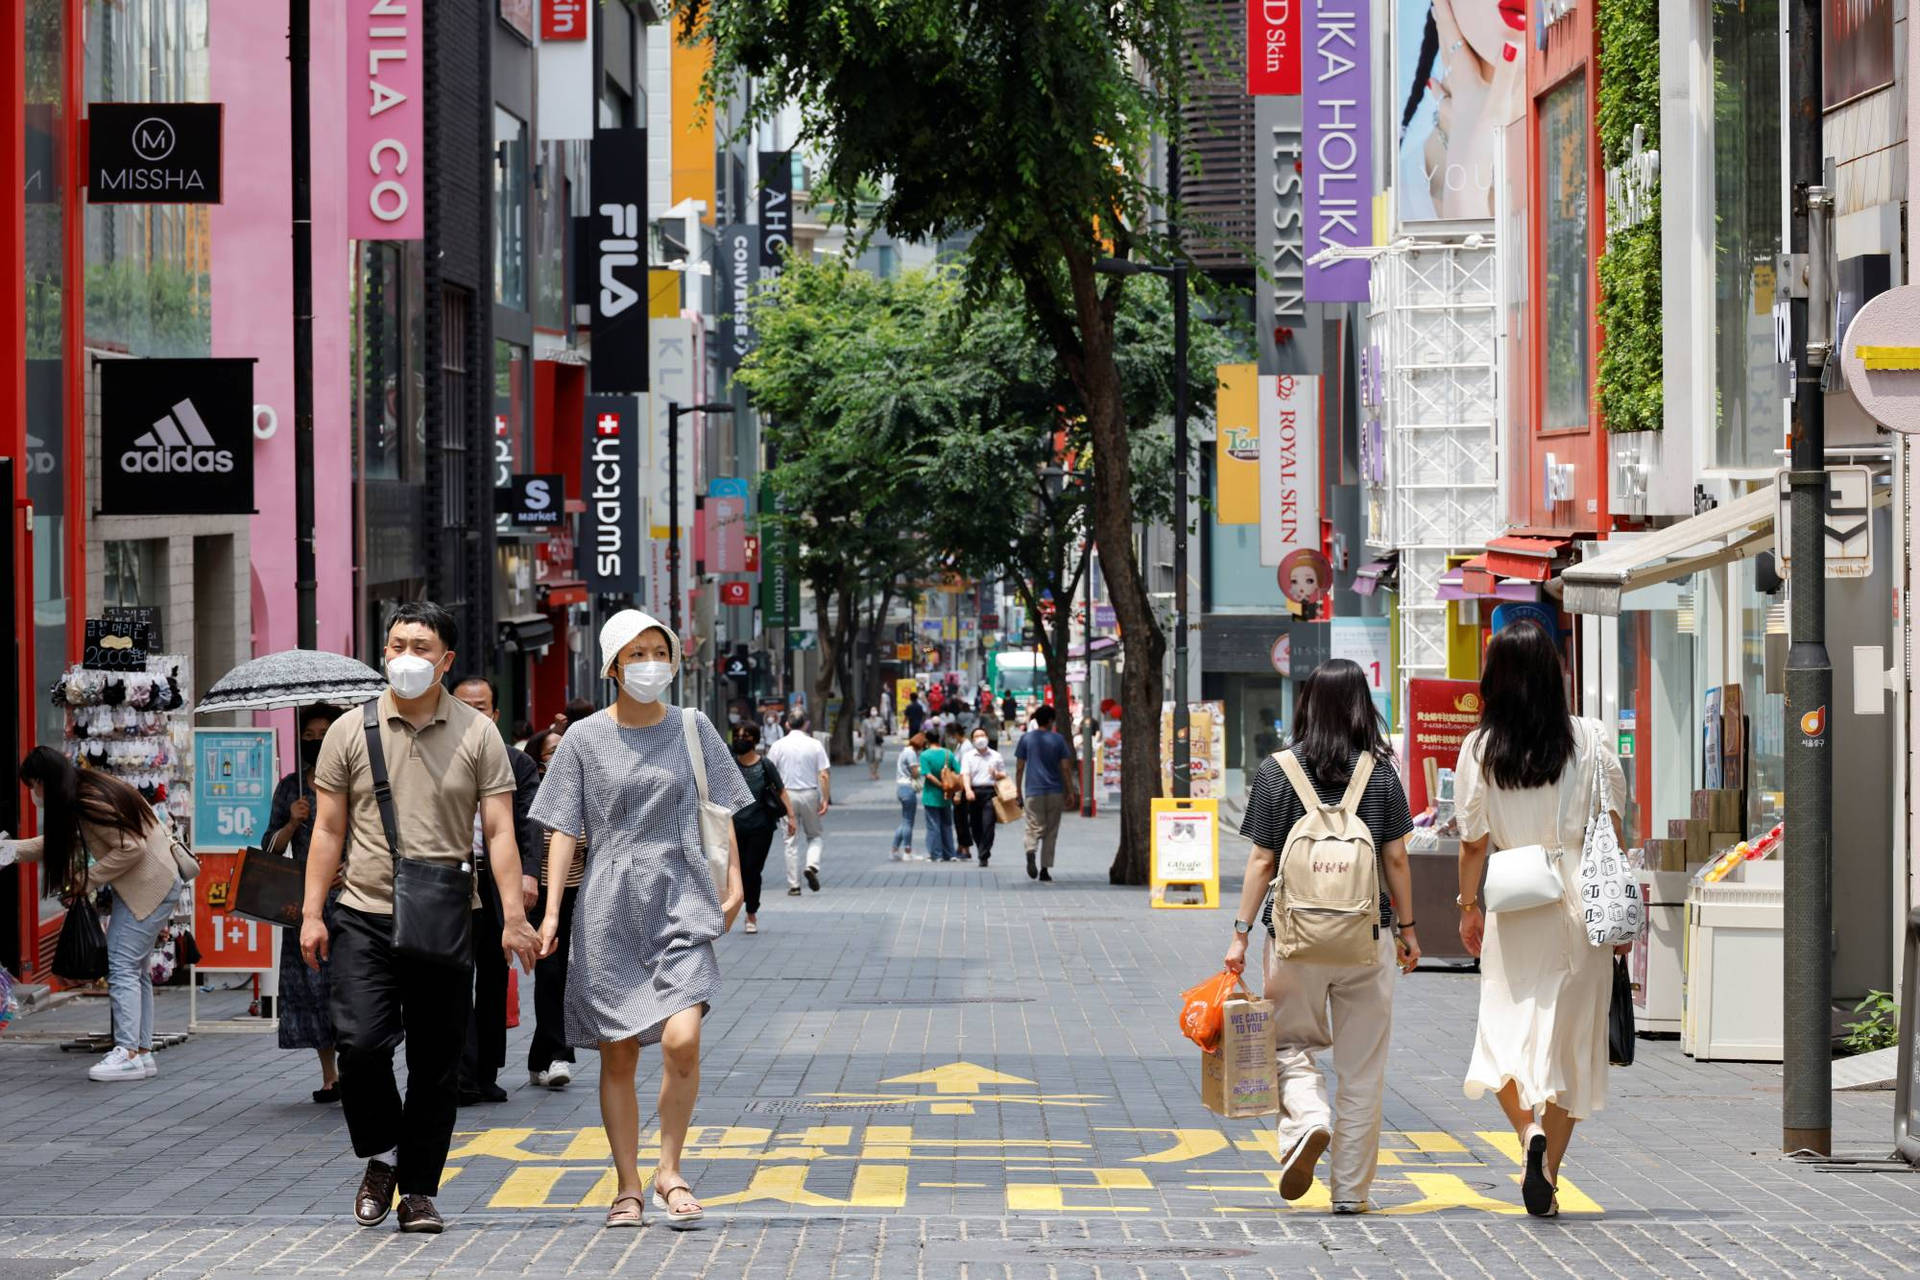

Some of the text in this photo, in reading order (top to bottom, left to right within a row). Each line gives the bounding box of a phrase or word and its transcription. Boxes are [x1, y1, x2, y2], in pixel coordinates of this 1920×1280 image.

[1317, 0, 1358, 270] IKA HOLIKA
[100, 168, 204, 190] MISSHA
[369, 138, 408, 221] CO
[765, 188, 787, 255] AHC
[599, 202, 639, 318] FILA
[733, 235, 749, 337] CONVERSE
[120, 446, 234, 473] adidas
[524, 479, 551, 510] S
[1280, 410, 1298, 544] ROYAL SKIN
[592, 439, 622, 577] swatch
[211, 915, 258, 953] 1+1
[1230, 1011, 1269, 1025] WE CATER
